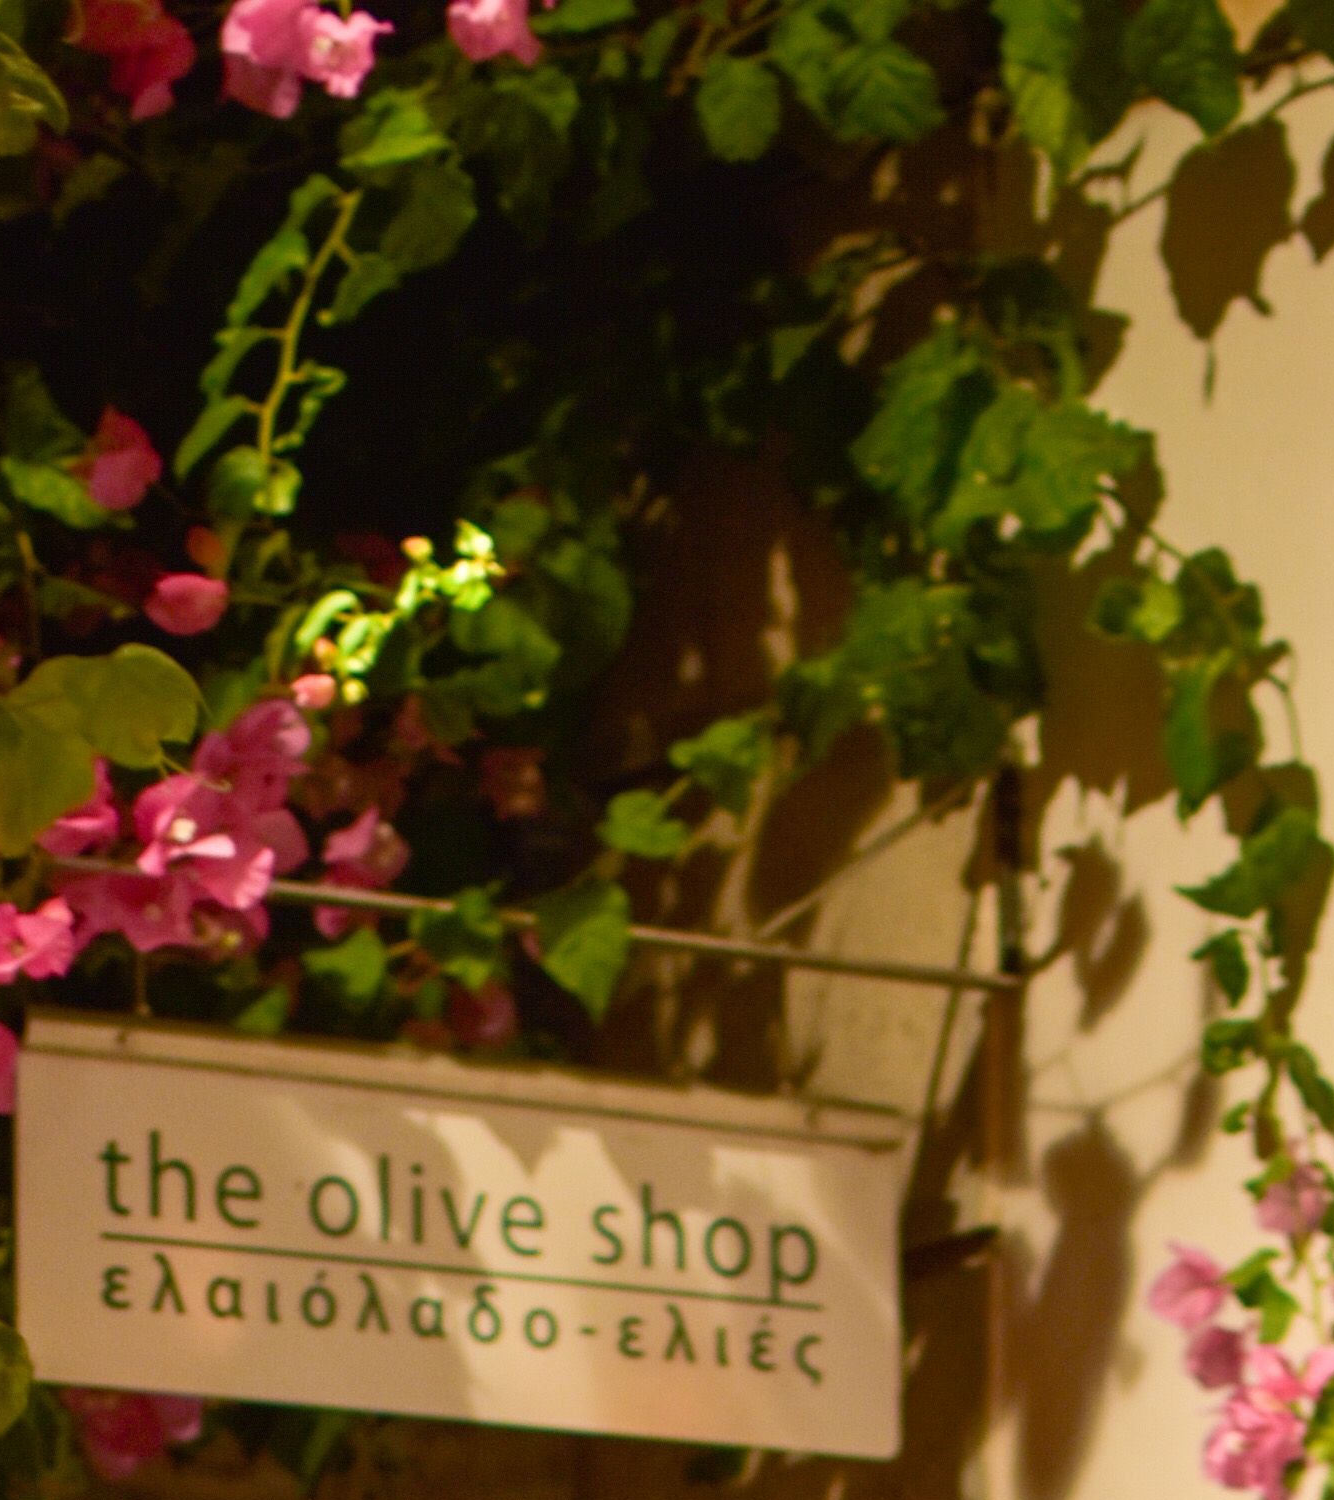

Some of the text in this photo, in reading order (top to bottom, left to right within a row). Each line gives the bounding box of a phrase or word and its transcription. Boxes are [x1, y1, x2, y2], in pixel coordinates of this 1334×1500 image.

[98, 1129, 818, 1302] the olive shop
[98, 1252, 824, 1386] ελαιόλαδο-ελιές
